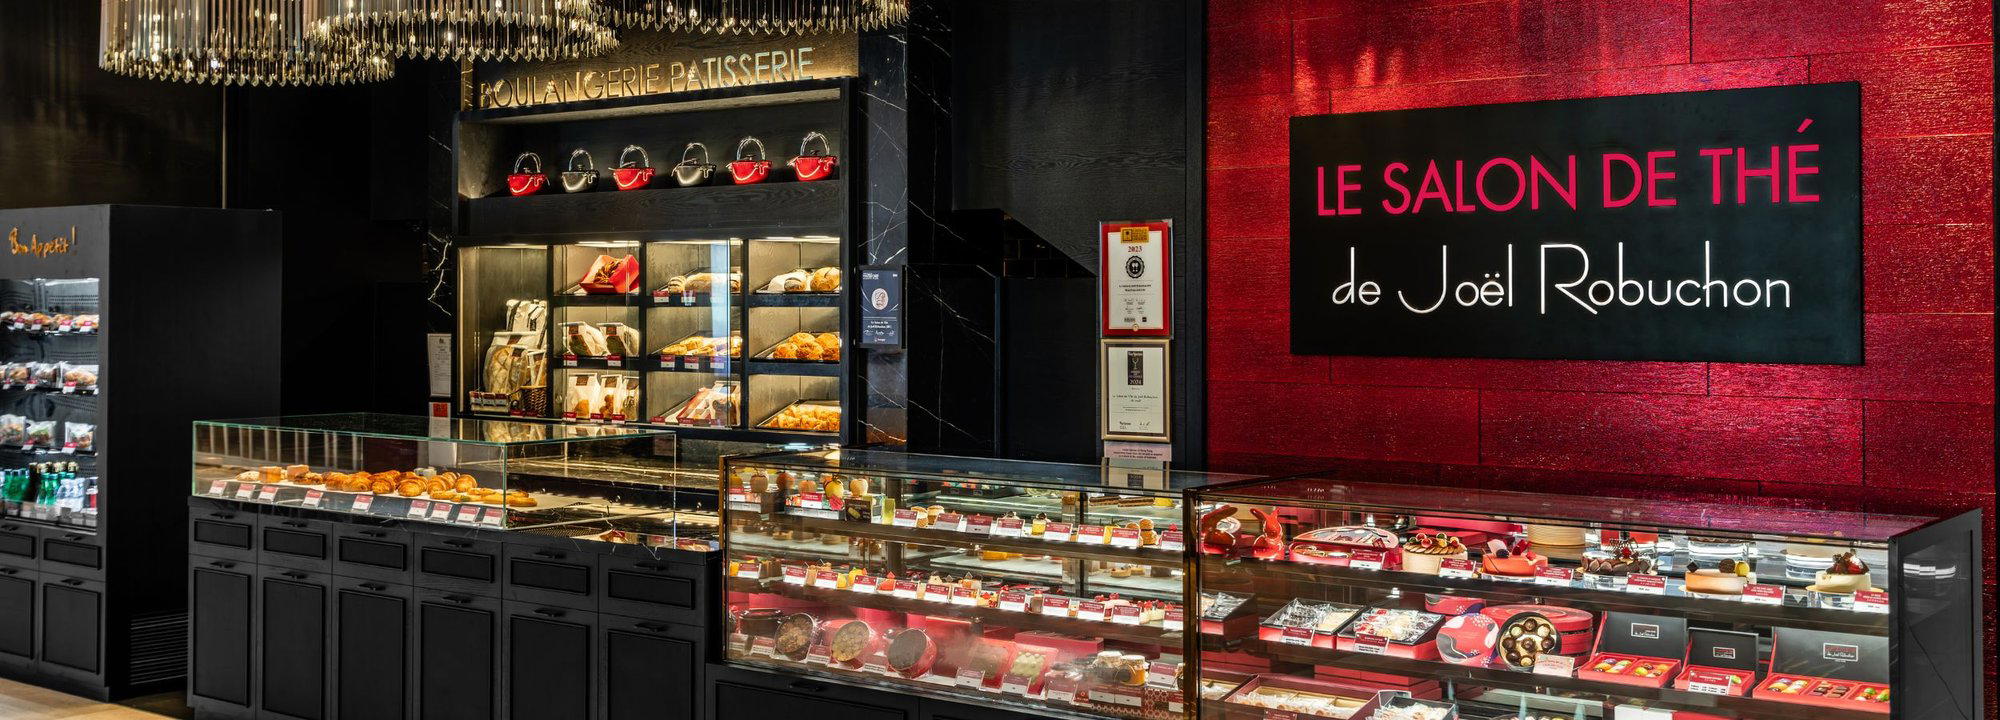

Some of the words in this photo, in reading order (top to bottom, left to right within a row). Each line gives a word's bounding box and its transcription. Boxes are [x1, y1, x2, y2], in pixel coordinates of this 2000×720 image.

[480, 64, 659, 109] BOULANGERIE
[671, 47, 814, 91] PATISSERIE
[1318, 165, 1361, 216] LE
[1382, 155, 1576, 214] SALON
[1603, 150, 1677, 208] DE
[1700, 119, 1819, 204] THÉ
[1333, 247, 1380, 305] de
[1398, 244, 1512, 313] Joël
[1541, 241, 1790, 314] Robuchon
